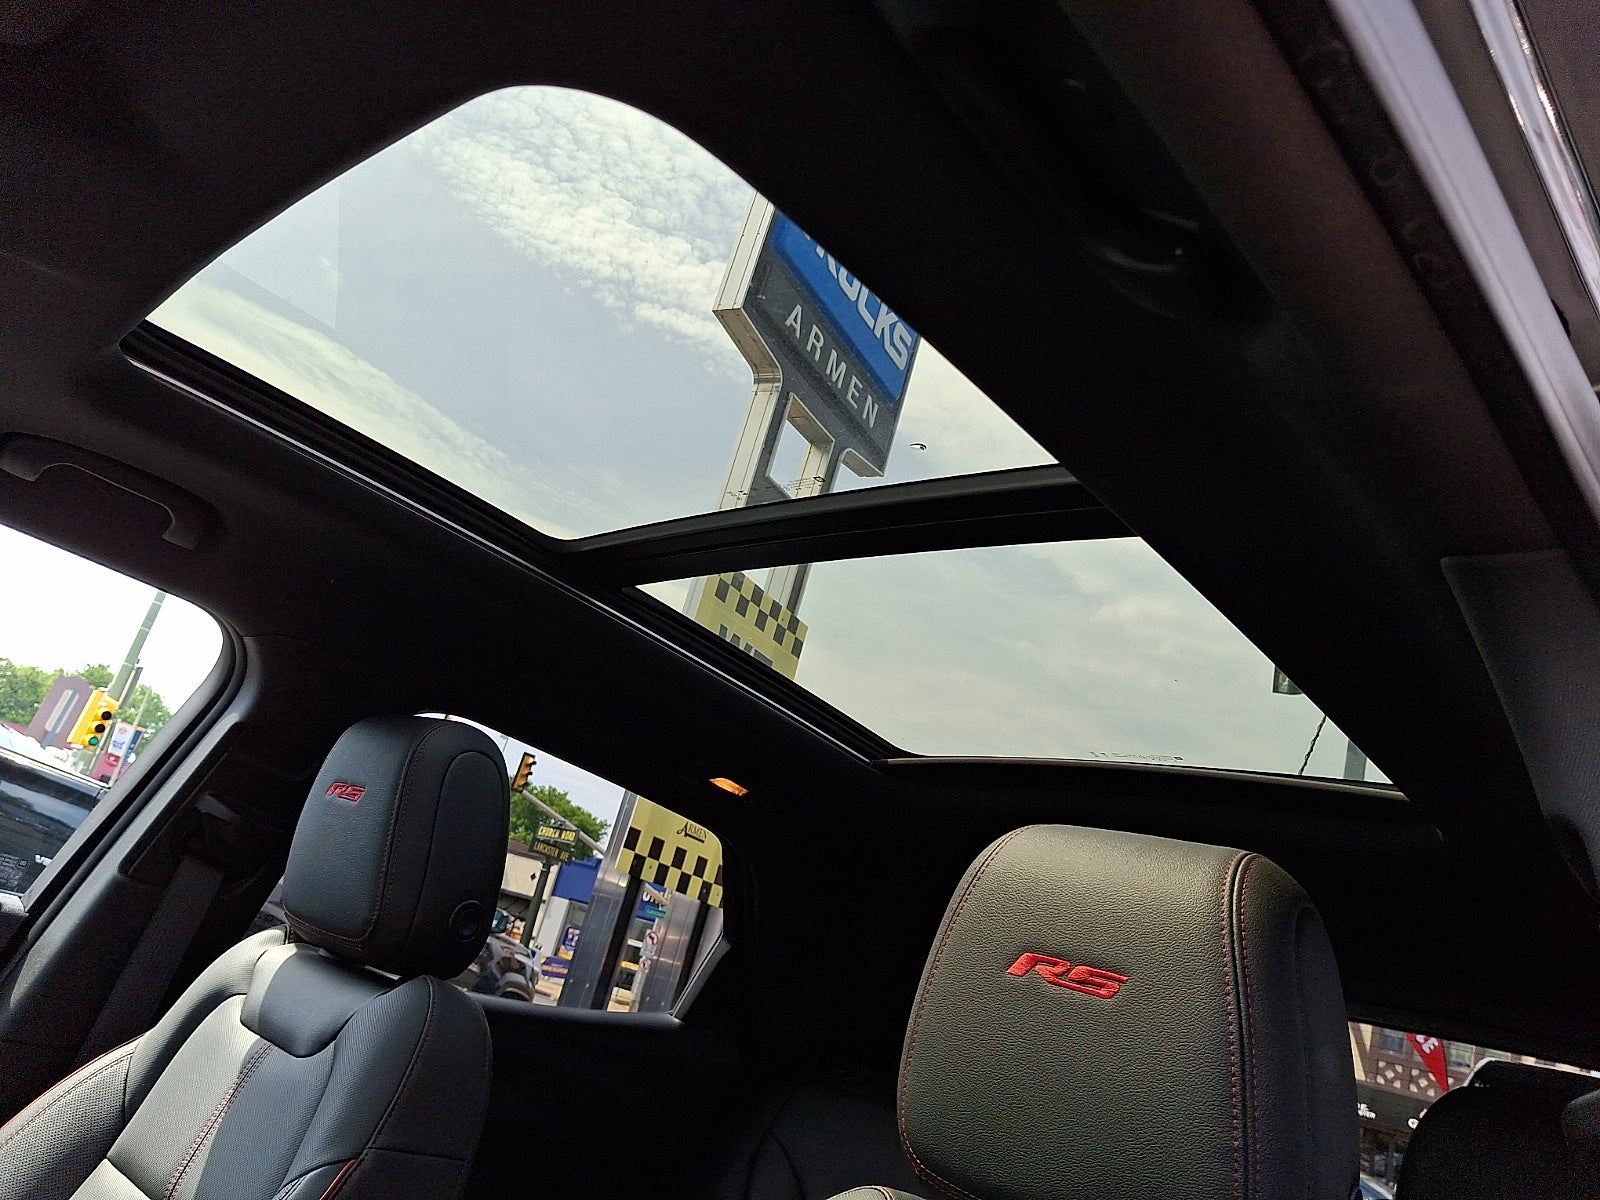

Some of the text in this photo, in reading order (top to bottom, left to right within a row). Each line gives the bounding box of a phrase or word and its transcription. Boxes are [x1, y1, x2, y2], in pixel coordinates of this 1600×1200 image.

[803, 232, 913, 371] UCKS
[784, 303, 879, 429] ARMEN
[326, 781, 367, 802] RS
[538, 826, 576, 842] CHURCH ROAD
[1005, 951, 1130, 1000] RS
